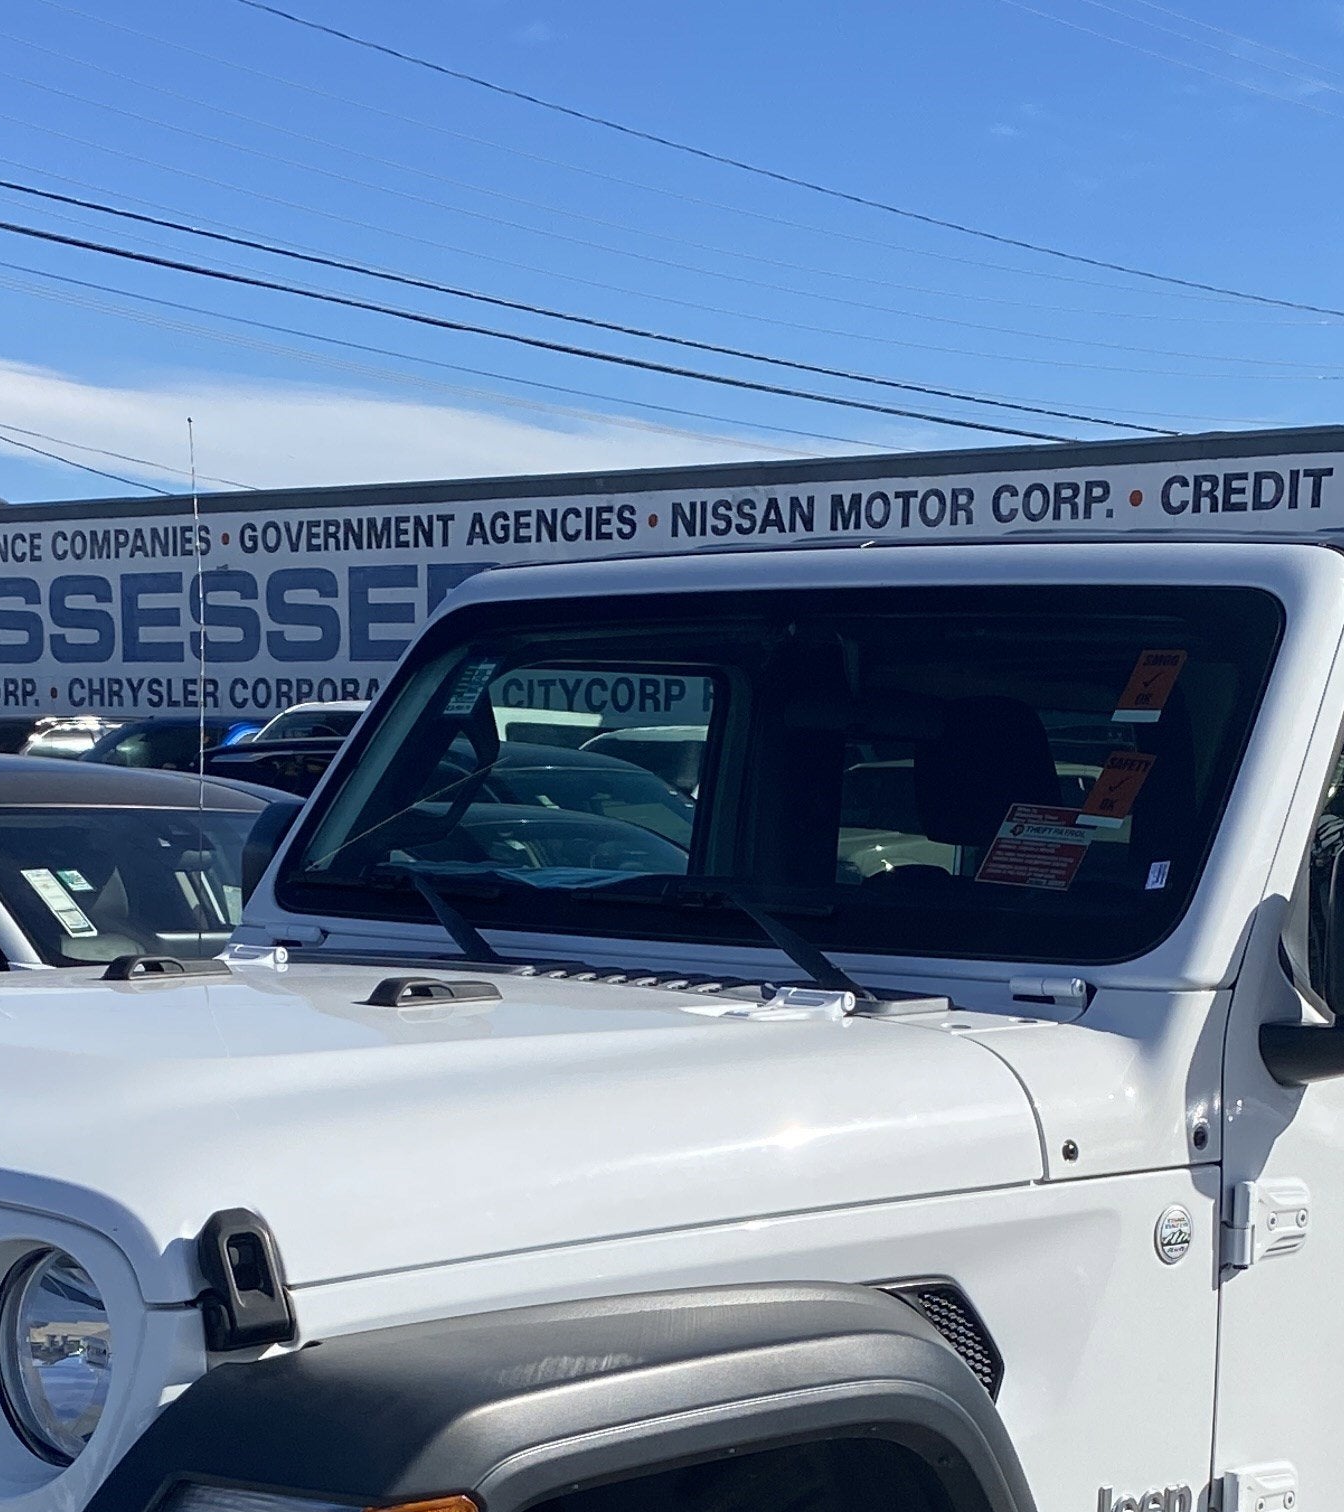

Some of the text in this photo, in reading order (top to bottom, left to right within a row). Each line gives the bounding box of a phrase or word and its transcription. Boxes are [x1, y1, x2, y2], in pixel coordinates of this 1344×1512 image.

[50, 525, 211, 561] COMPANIES
[239, 513, 455, 553] GOVERNMENT
[466, 504, 637, 546] AGENCIES
[670, 494, 816, 539] NISSAN
[828, 486, 974, 531] MOTOR
[991, 479, 1113, 523] CORP.
[1160, 466, 1334, 516] CREDIT
[67, 677, 219, 708] CHRYSLER
[502, 676, 687, 713] CITYCORP
